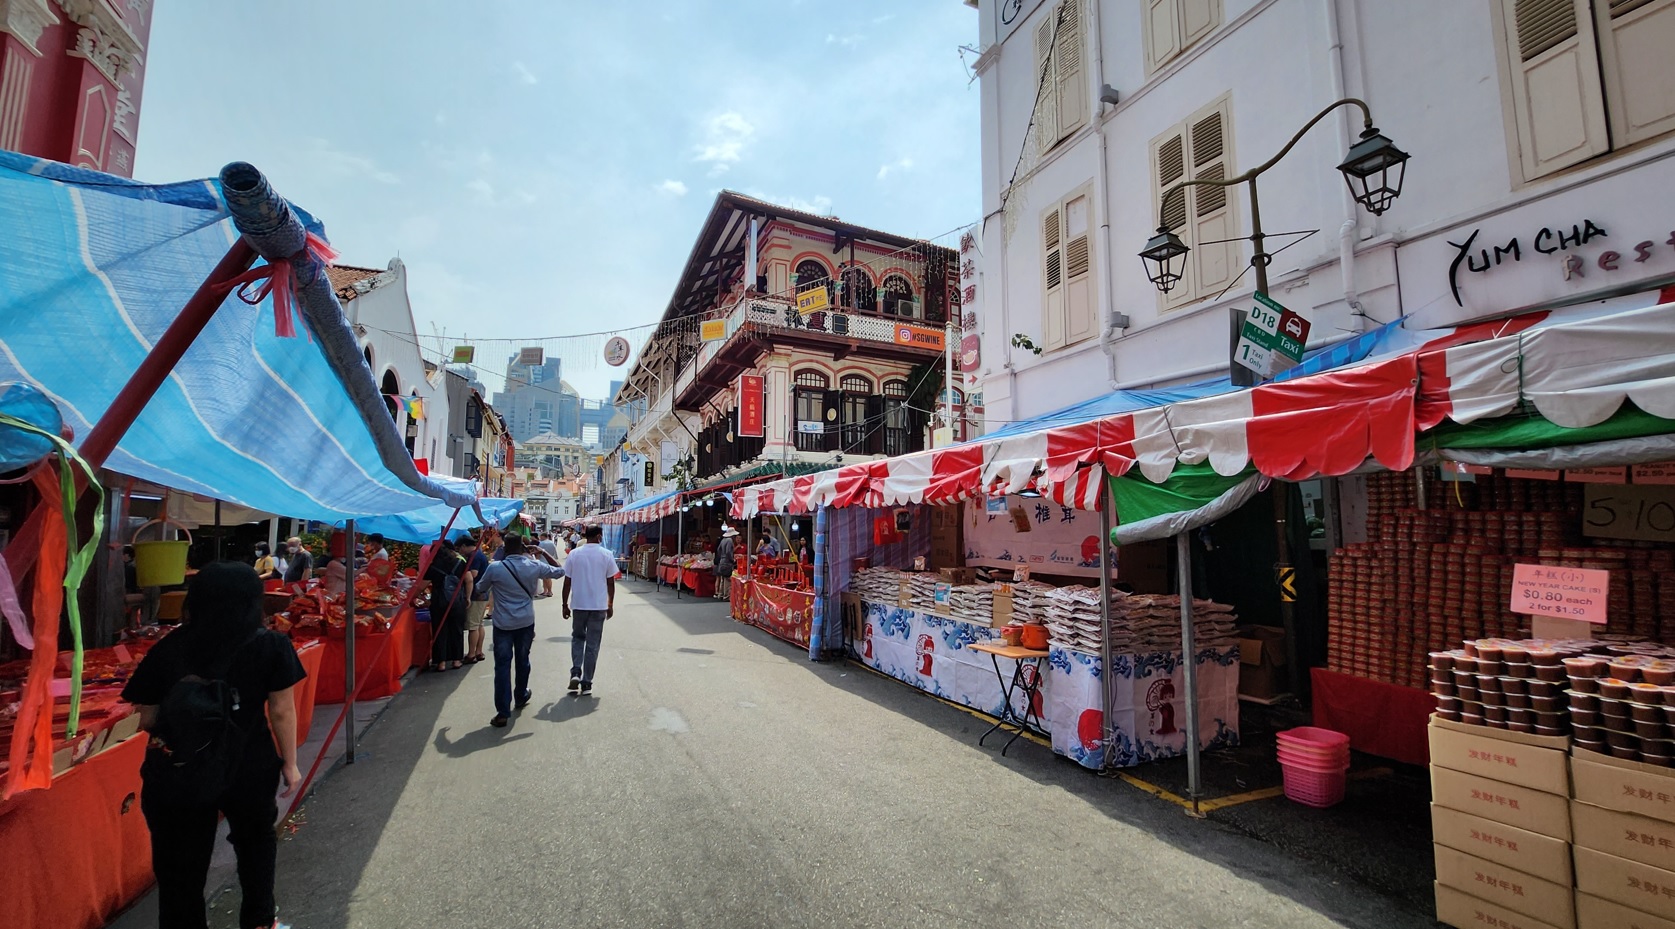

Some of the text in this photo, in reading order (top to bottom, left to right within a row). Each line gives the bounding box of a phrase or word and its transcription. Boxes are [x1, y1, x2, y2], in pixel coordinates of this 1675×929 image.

[1447, 219, 1608, 307] YUM CHA
[1251, 306, 1276, 328] D18
[912, 332, 941, 346] #SGWINE
[1280, 335, 1300, 354] Taxi
[1242, 344, 1250, 360] 1
[1252, 349, 1263, 360] Taxi
[1249, 358, 1262, 369] Only
[1587, 497, 1616, 526] 5
[1523, 589, 1563, 602] $0.80
[1562, 583, 1586, 592] CAKE
[1555, 606, 1585, 615] $1.50
[1468, 749, 1518, 768] 发财年糕
[1471, 788, 1520, 810] 发财年糕
[1622, 784, 1675, 804] 发财年
[1470, 829, 1519, 852] 发财年糕
[1474, 871, 1525, 897] 发财年糕
[1474, 909, 1522, 929] 发财年
